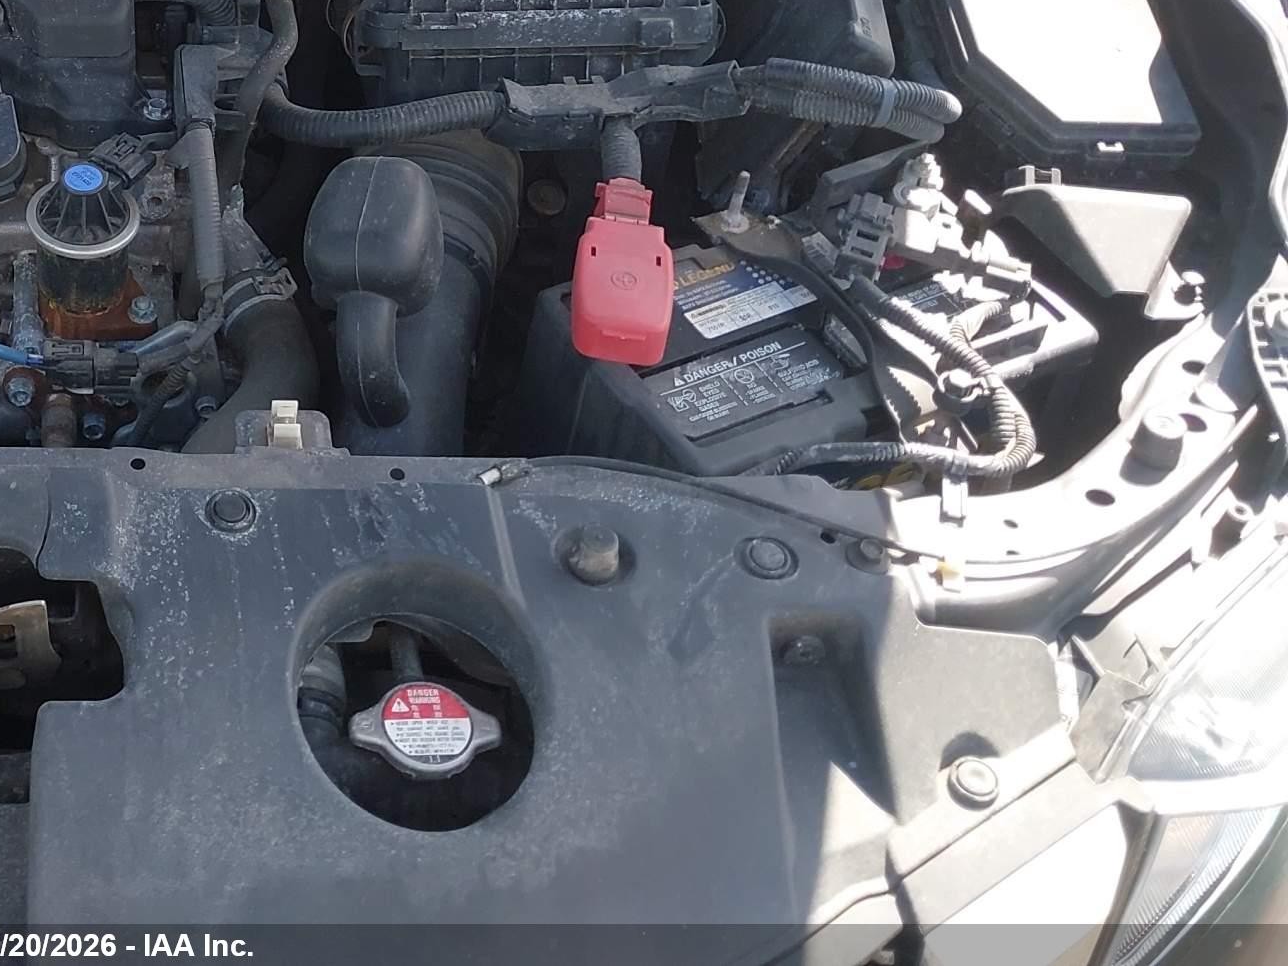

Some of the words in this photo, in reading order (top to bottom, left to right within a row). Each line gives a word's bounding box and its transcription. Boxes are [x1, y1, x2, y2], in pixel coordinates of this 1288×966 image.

[679, 262, 735, 287] LEGEND
[683, 360, 731, 383] DANGER
[738, 341, 782, 362] POISON
[406, 689, 440, 697] DANGER
